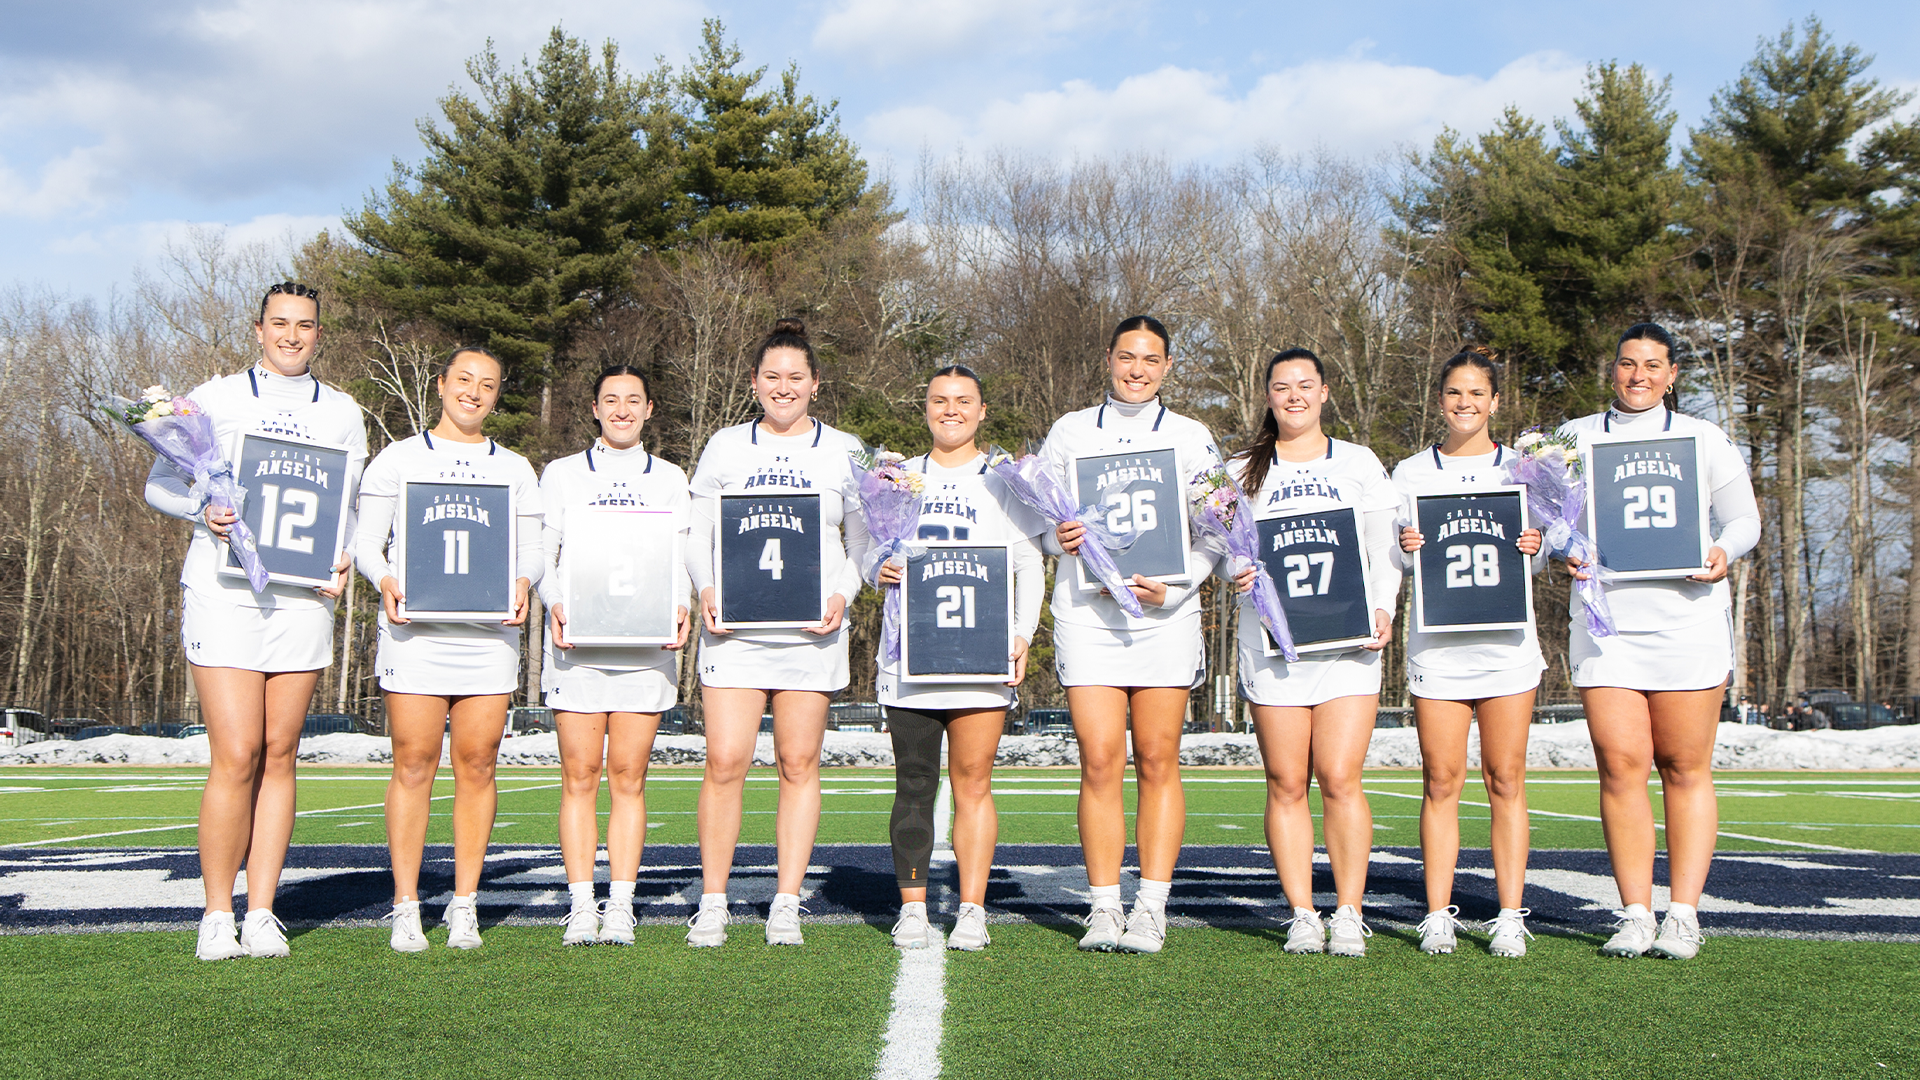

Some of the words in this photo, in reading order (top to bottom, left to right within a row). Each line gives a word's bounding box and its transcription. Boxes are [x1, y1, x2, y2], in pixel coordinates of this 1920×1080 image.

[269, 450, 321, 466] SAINT
[1104, 458, 1151, 471] SAINT
[1623, 451, 1671, 462] SAINT
[254, 459, 329, 490] ANSELM
[439, 471, 486, 479] SAIN
[744, 474, 812, 489] ANSELM
[757, 467, 804, 475] SAINT
[1096, 466, 1164, 491] ANSELM
[1280, 477, 1328, 487] SAINT
[1613, 460, 1683, 483] ANSELM
[433, 493, 480, 505] SAINT
[924, 495, 970, 503] SAINT
[1267, 483, 1342, 507] ANSELM
[258, 482, 320, 556] 12
[422, 503, 491, 528] ANSELM
[748, 504, 793, 514] SAINT
[917, 502, 977, 525] NSELM
[1106, 489, 1158, 534] 26
[1446, 508, 1493, 520] SAINT
[1622, 485, 1678, 530] 29
[738, 513, 804, 535] ANSELM
[1281, 519, 1326, 531] SAINT
[1437, 518, 1506, 543] ANSELM
[443, 529, 469, 574] 11
[1273, 528, 1340, 552] ANSELM
[758, 538, 784, 580] 4
[931, 551, 979, 562] SAINT
[1445, 544, 1501, 589] 28
[921, 560, 989, 583] ANSELM
[1283, 551, 1335, 598] 27
[936, 585, 976, 629] 21
